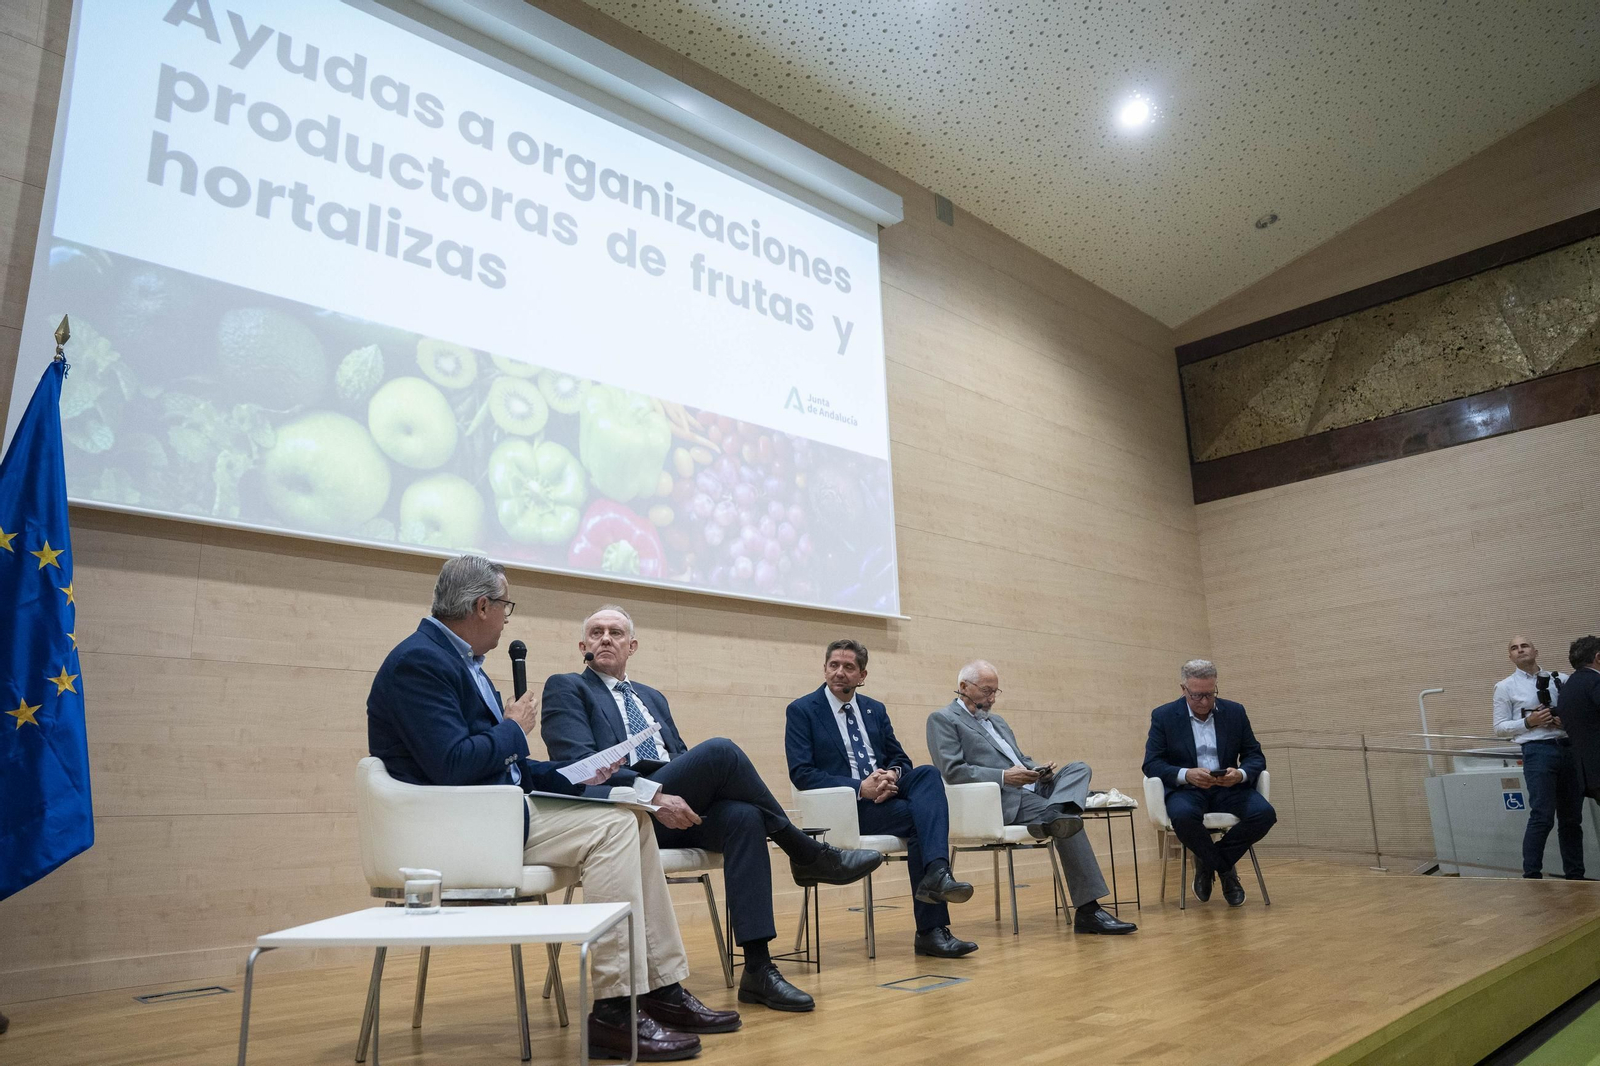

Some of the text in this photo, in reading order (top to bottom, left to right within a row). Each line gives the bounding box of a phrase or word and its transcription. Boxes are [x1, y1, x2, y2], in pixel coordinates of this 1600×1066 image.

[147, 131, 507, 290] hortalizas
[154, 62, 854, 355] productoras de frutas y
[163, 0, 851, 293] Ayudas a organizaciones
[807, 394, 830, 408] Junta
[807, 404, 858, 426] de Andalucía
